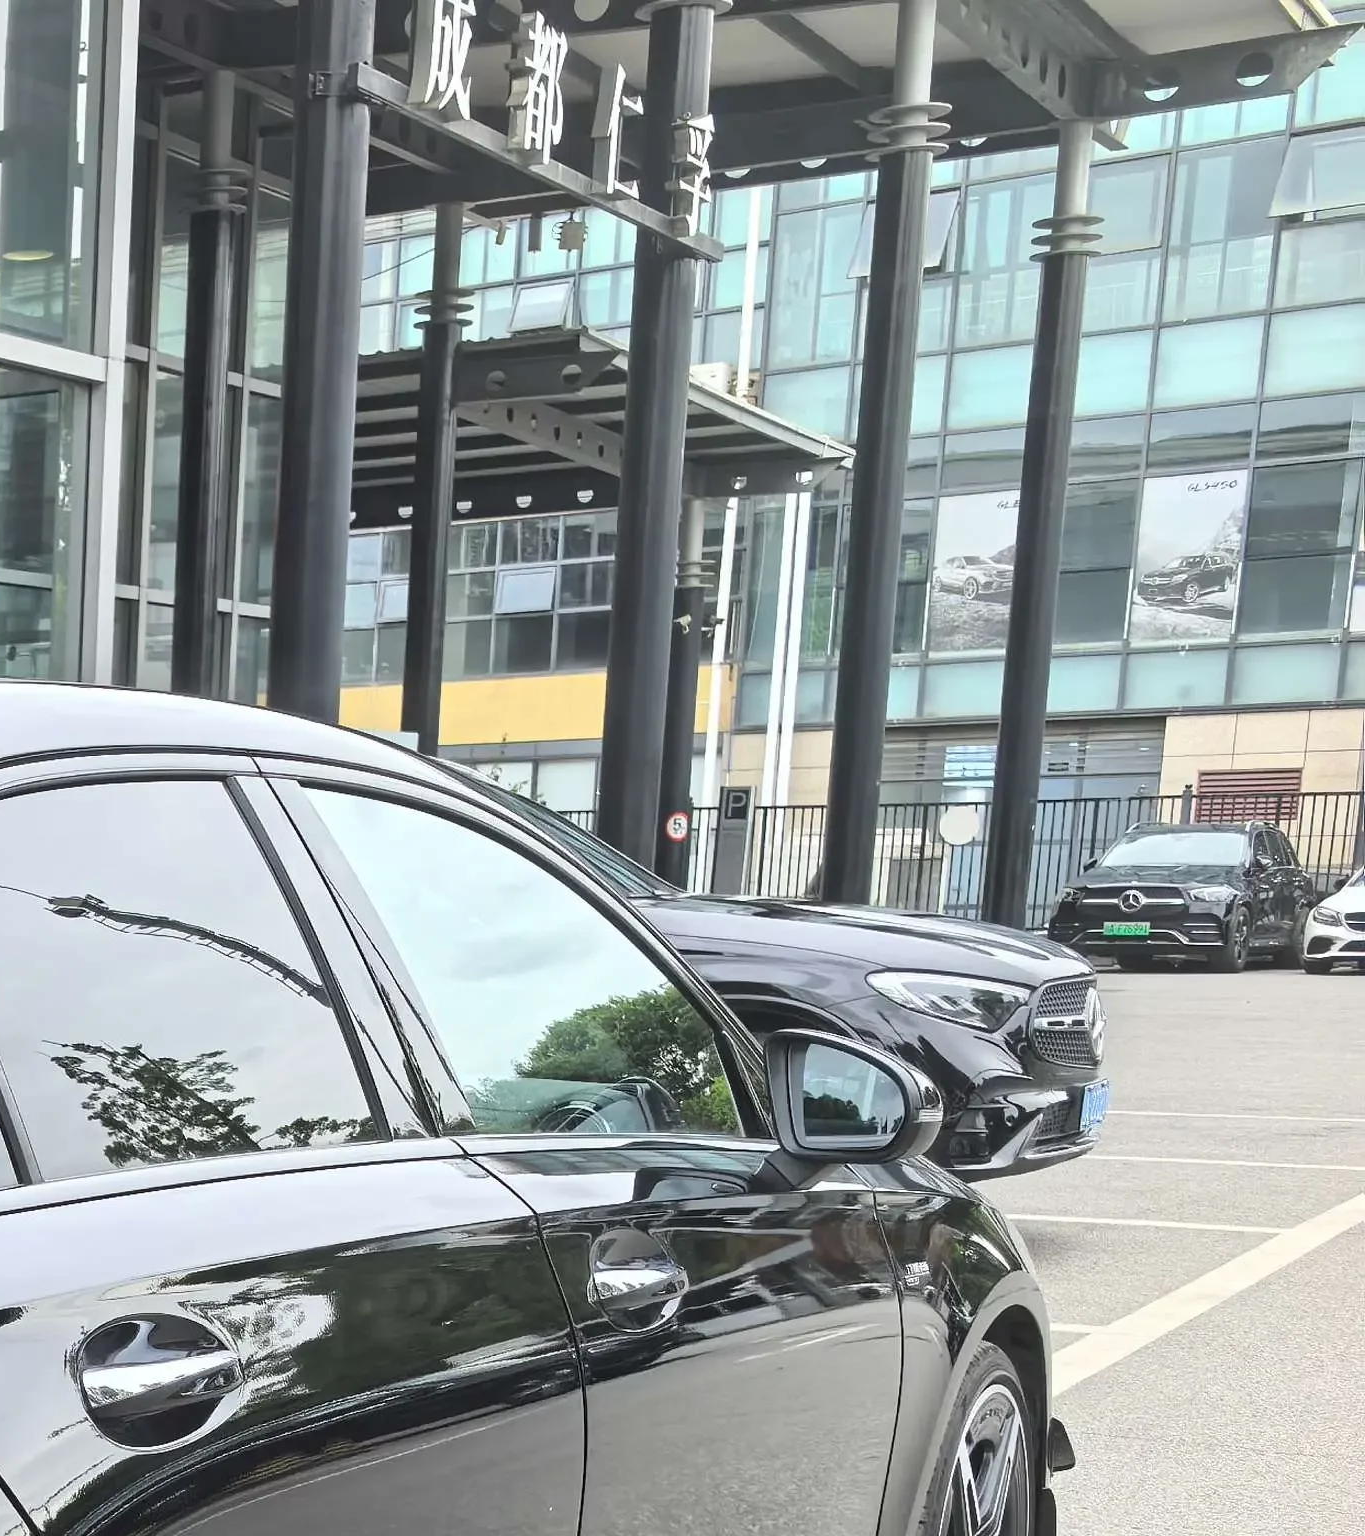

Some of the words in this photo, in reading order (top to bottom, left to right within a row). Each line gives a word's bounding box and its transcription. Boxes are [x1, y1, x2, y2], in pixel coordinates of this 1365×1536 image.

[424, 0, 716, 237] 成都仁孚
[727, 791, 747, 817] P
